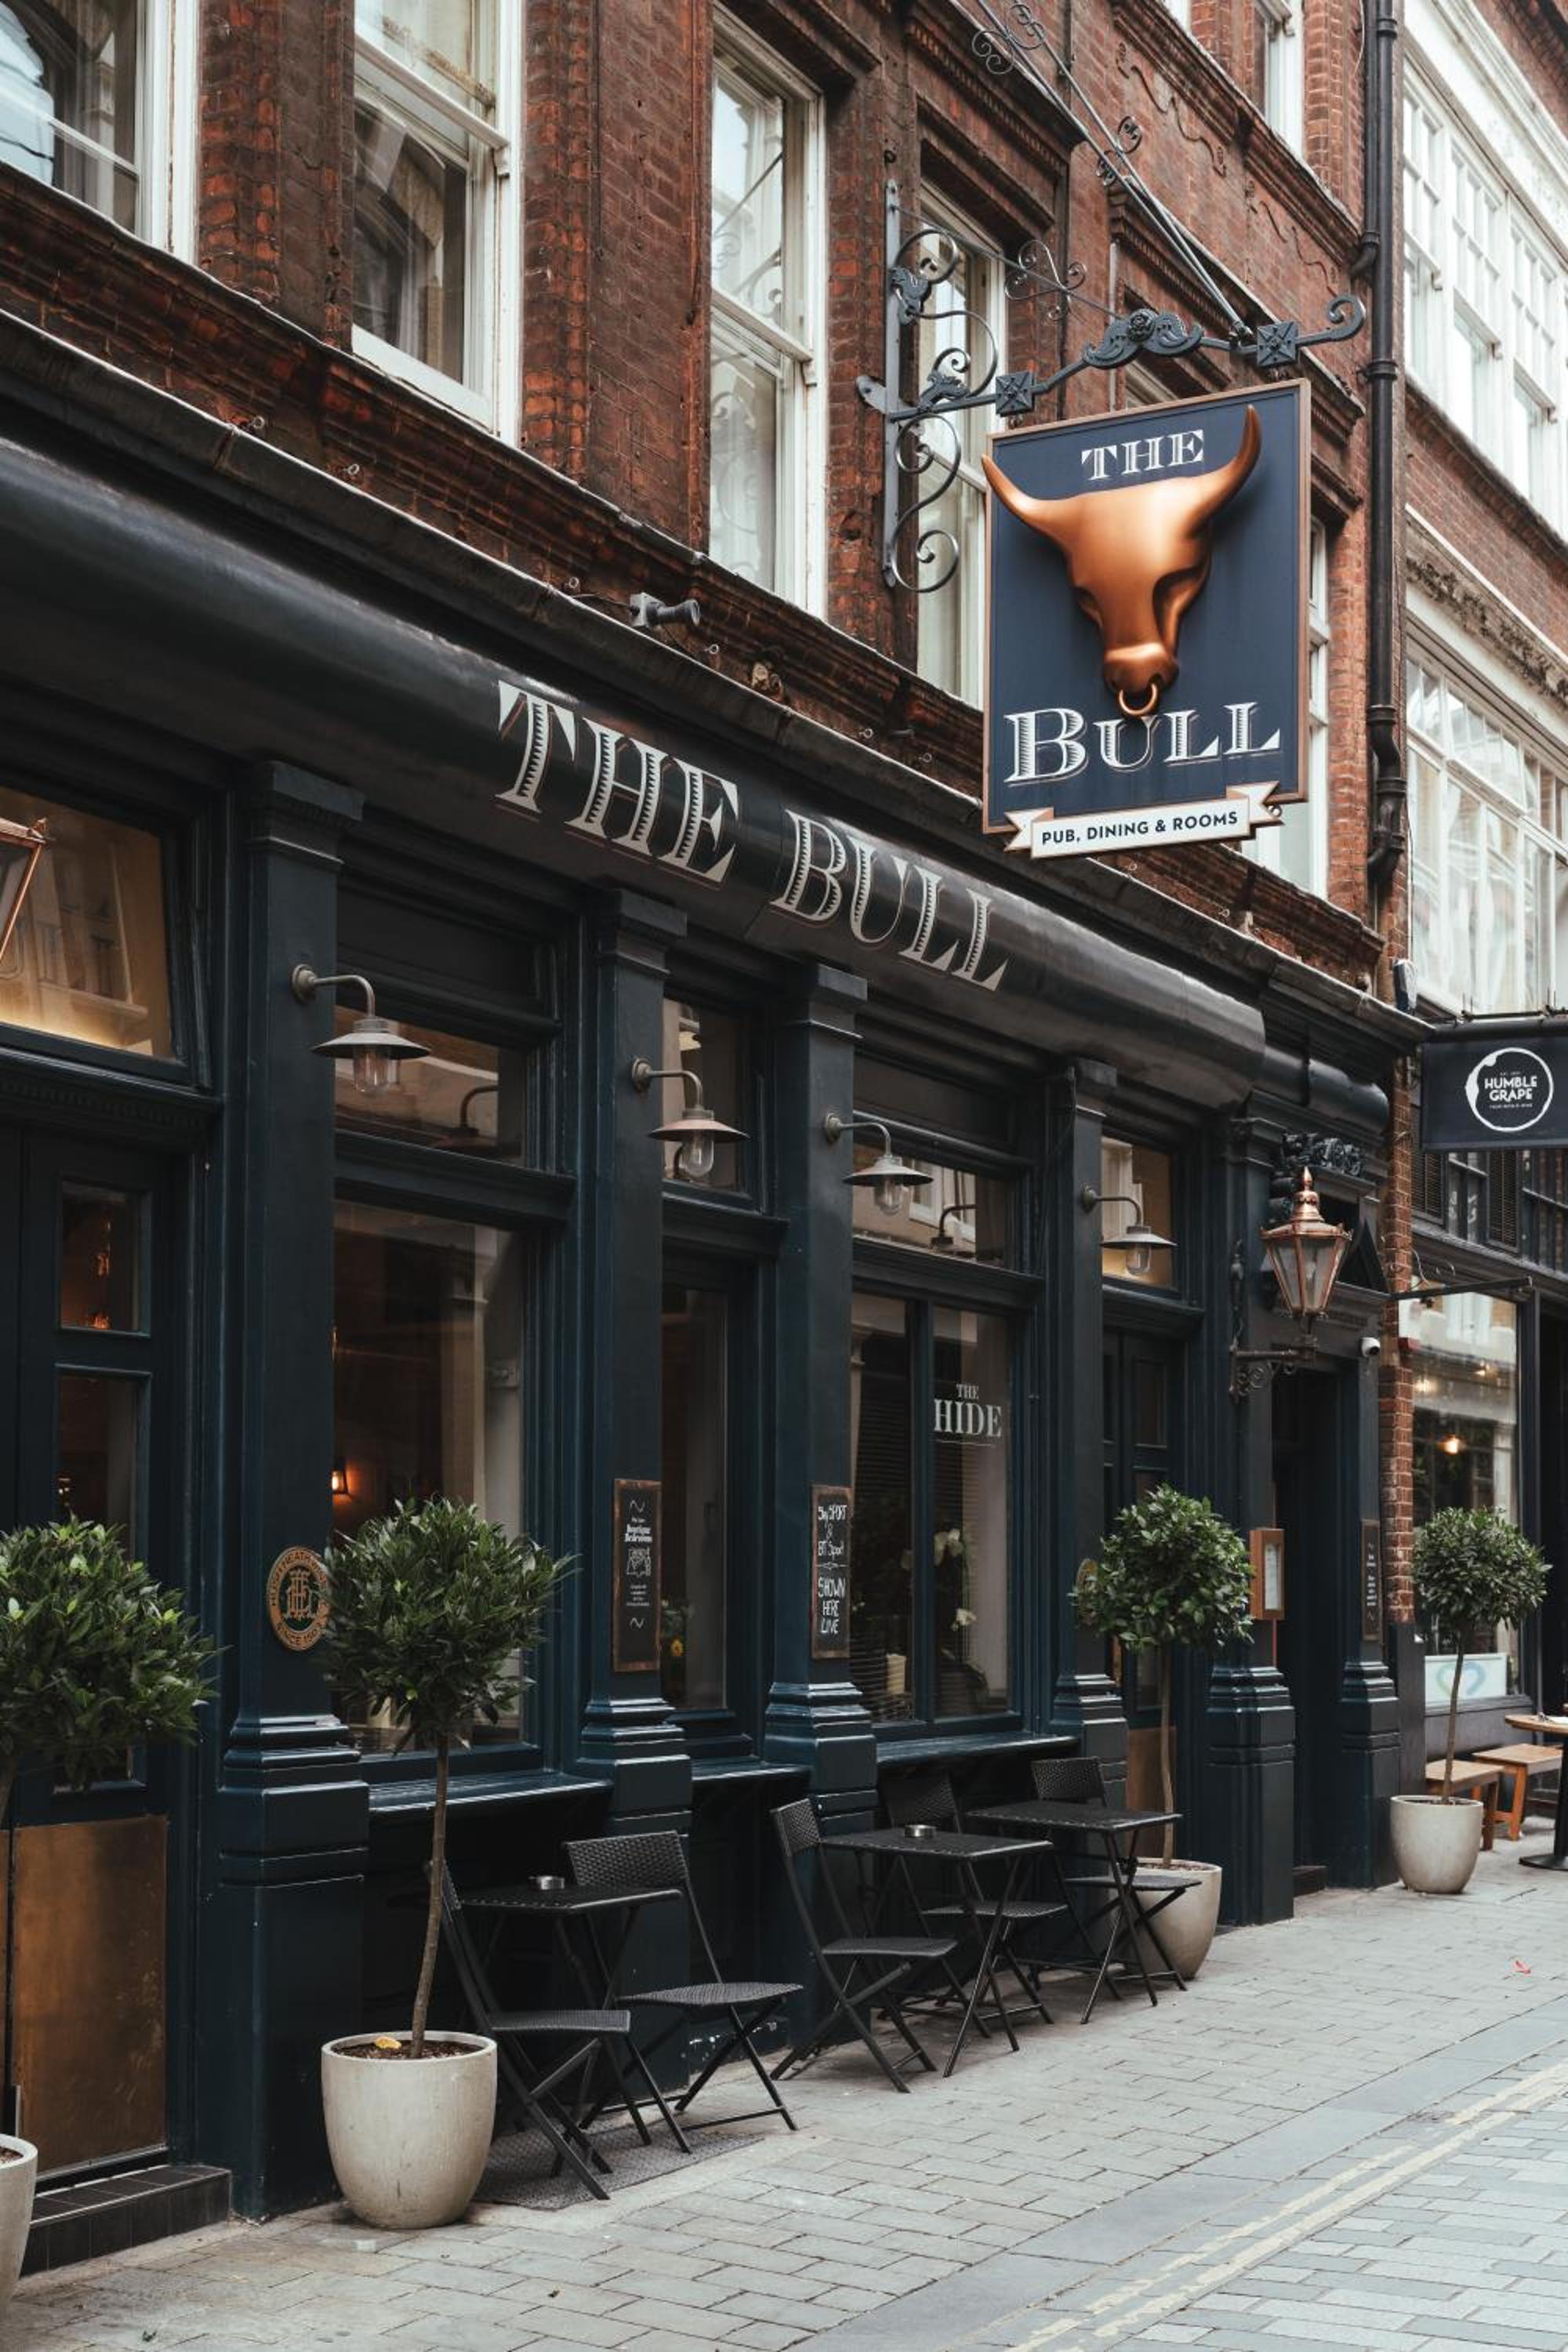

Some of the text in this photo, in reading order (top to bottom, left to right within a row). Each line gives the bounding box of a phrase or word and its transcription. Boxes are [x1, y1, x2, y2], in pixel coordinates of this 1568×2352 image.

[1081, 429, 1205, 481] THE
[1003, 702, 1282, 787] BULL
[495, 680, 1008, 993] THE BULL
[1041, 811, 1239, 846] PUB, DINING & ROOMS
[1484, 1076, 1537, 1089] HUMBLE
[1489, 1088, 1533, 1102] GRAPE
[956, 1384, 979, 1399] THE
[934, 1399, 1002, 1437] HIDE
[822, 1599, 840, 1617] HERE
